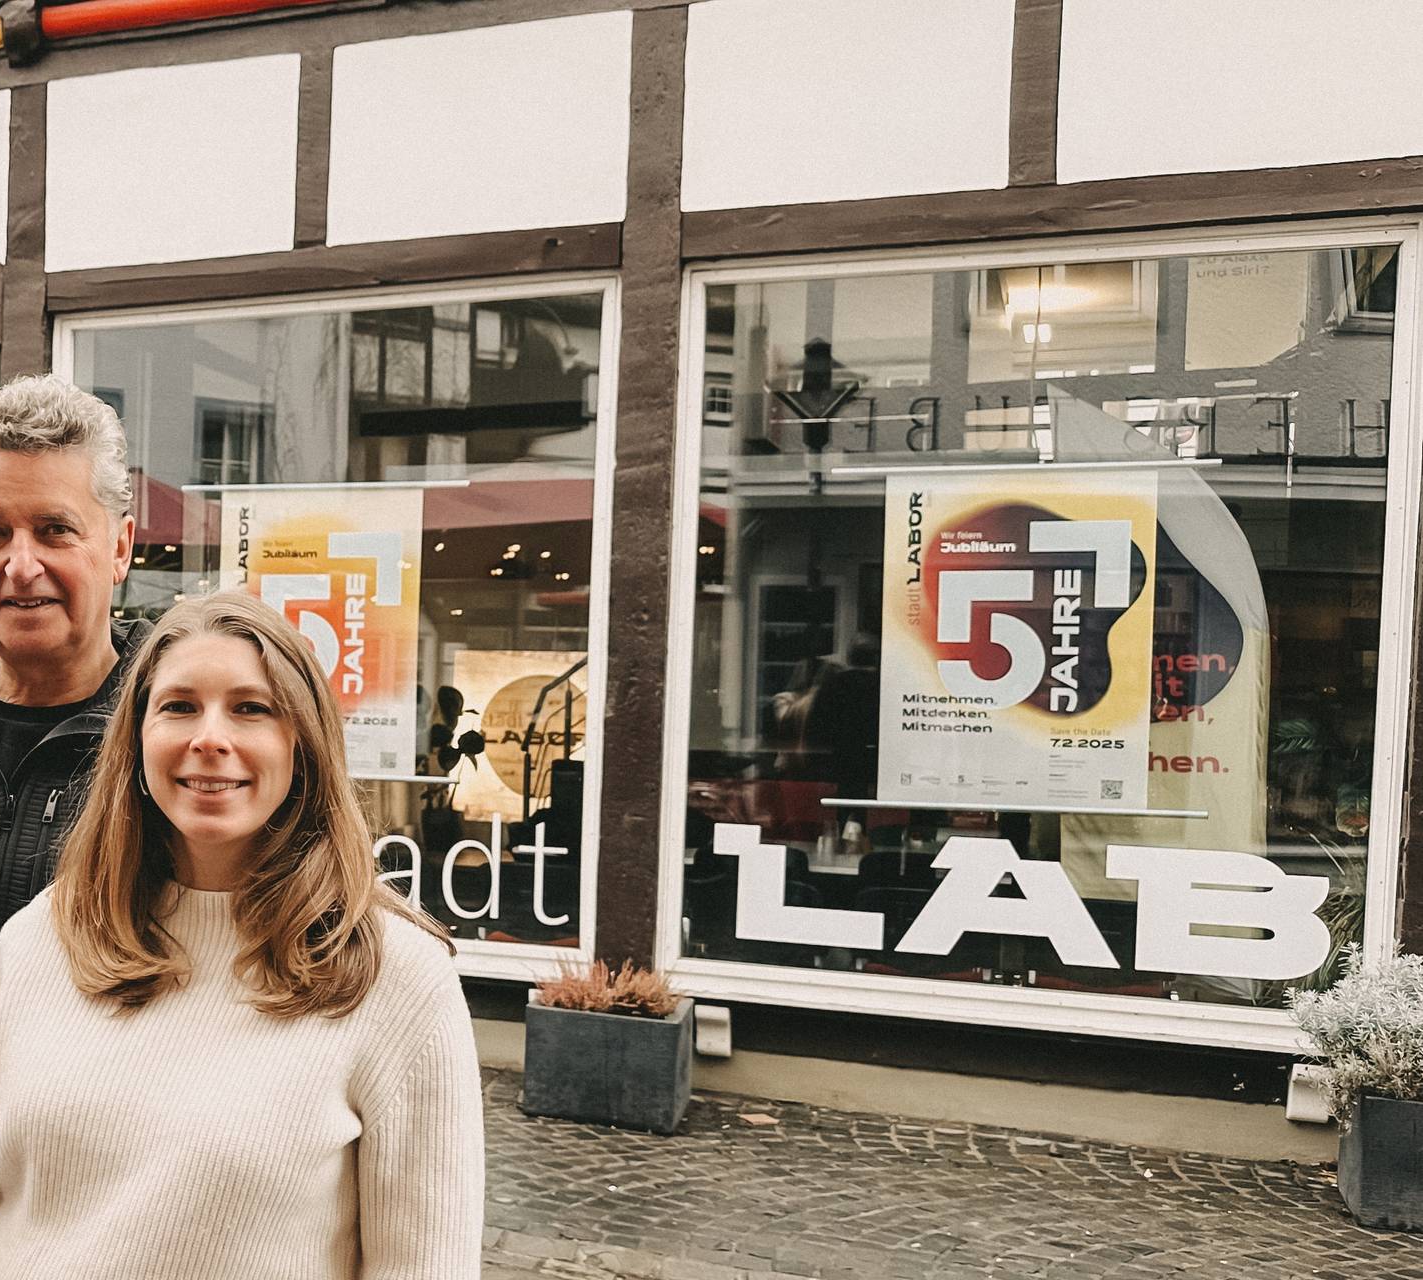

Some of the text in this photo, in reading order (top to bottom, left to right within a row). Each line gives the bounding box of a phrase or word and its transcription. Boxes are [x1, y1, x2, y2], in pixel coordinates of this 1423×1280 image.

[237, 506, 250, 587] LABOR
[906, 491, 923, 585] LABOR
[939, 540, 1017, 553] Jubiläum
[341, 572, 367, 695] JAHRE
[937, 569, 1046, 710] 5
[1049, 568, 1082, 713] JAHRE
[901, 721, 993, 733] Mitmachen
[372, 812, 570, 926] adt
